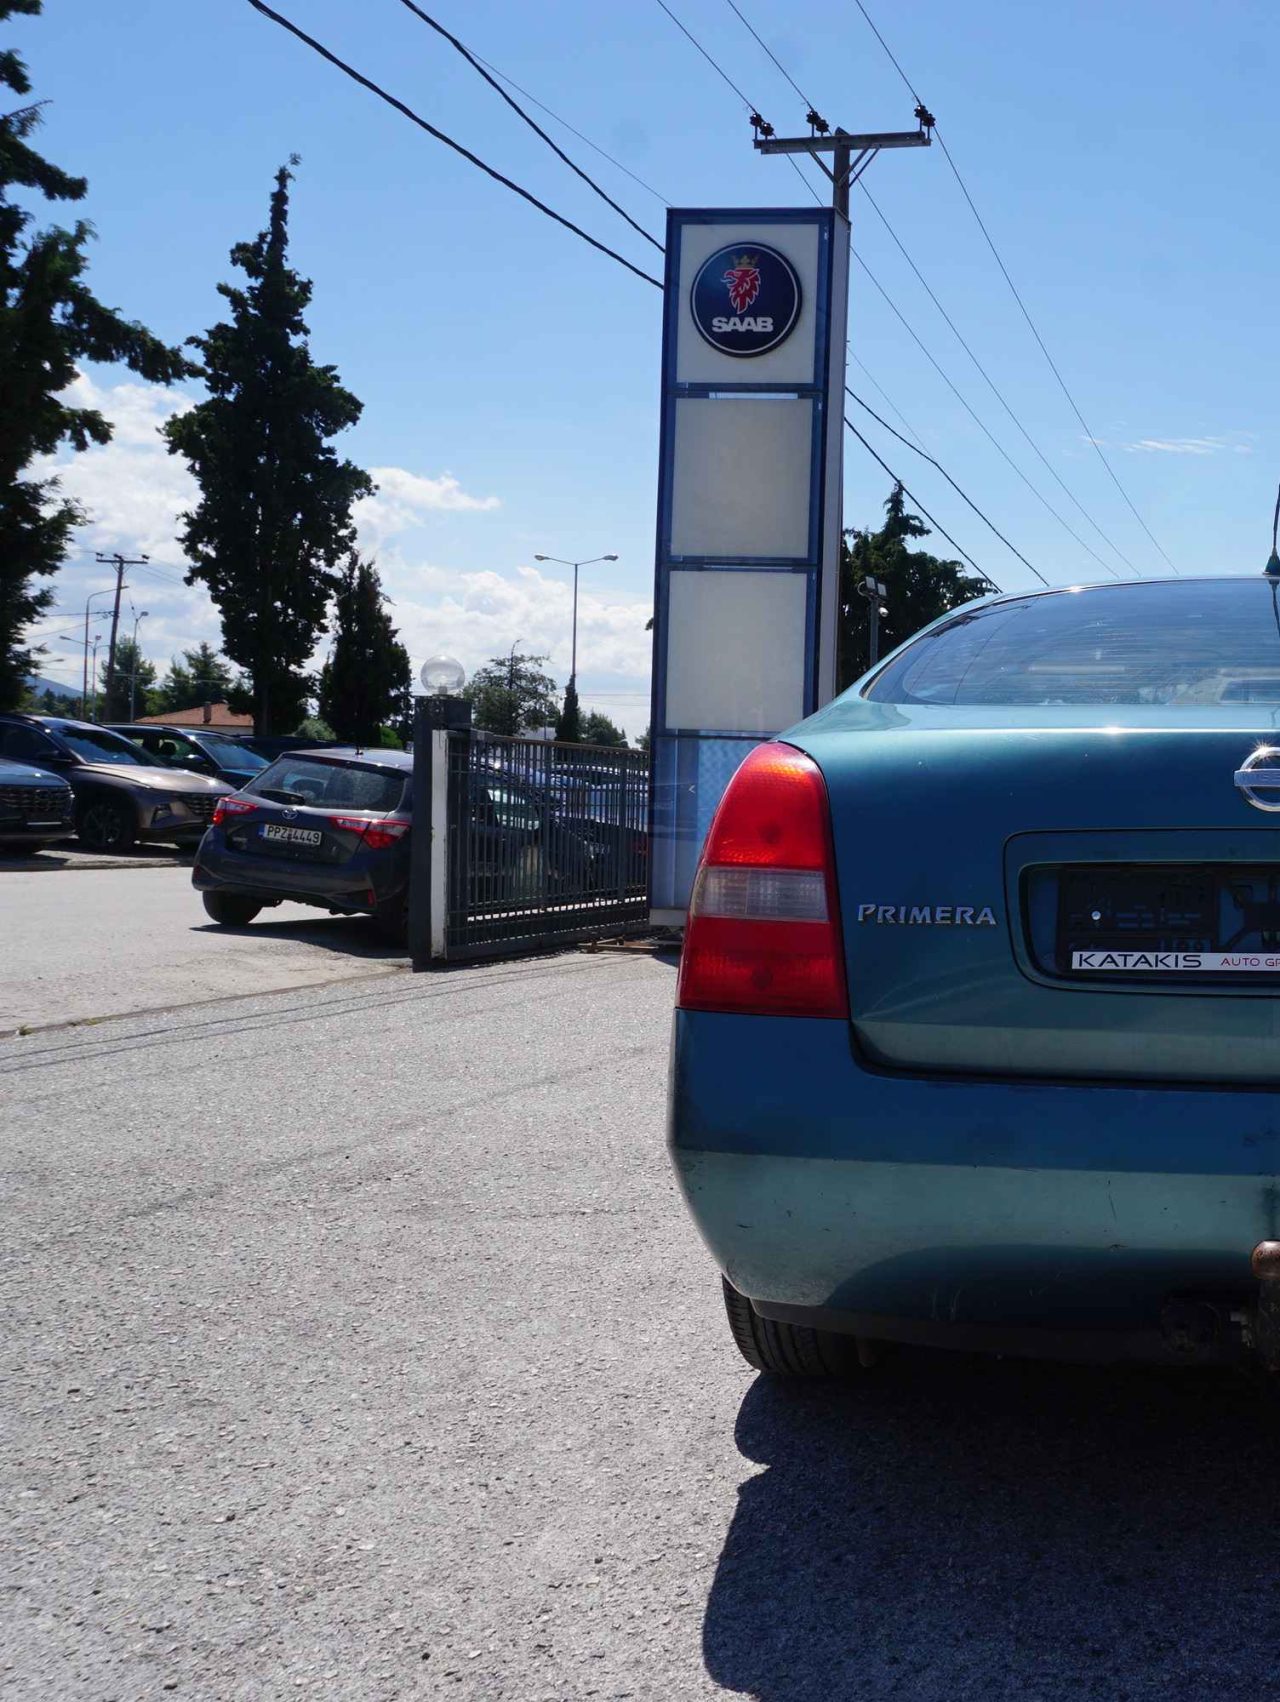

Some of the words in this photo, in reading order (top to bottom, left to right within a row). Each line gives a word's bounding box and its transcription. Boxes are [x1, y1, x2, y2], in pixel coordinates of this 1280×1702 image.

[712, 316, 774, 333] SAAB
[857, 903, 997, 926] PRIMERA
[1078, 953, 1202, 969] KATAKIS
[1220, 957, 1261, 967] AUTO
